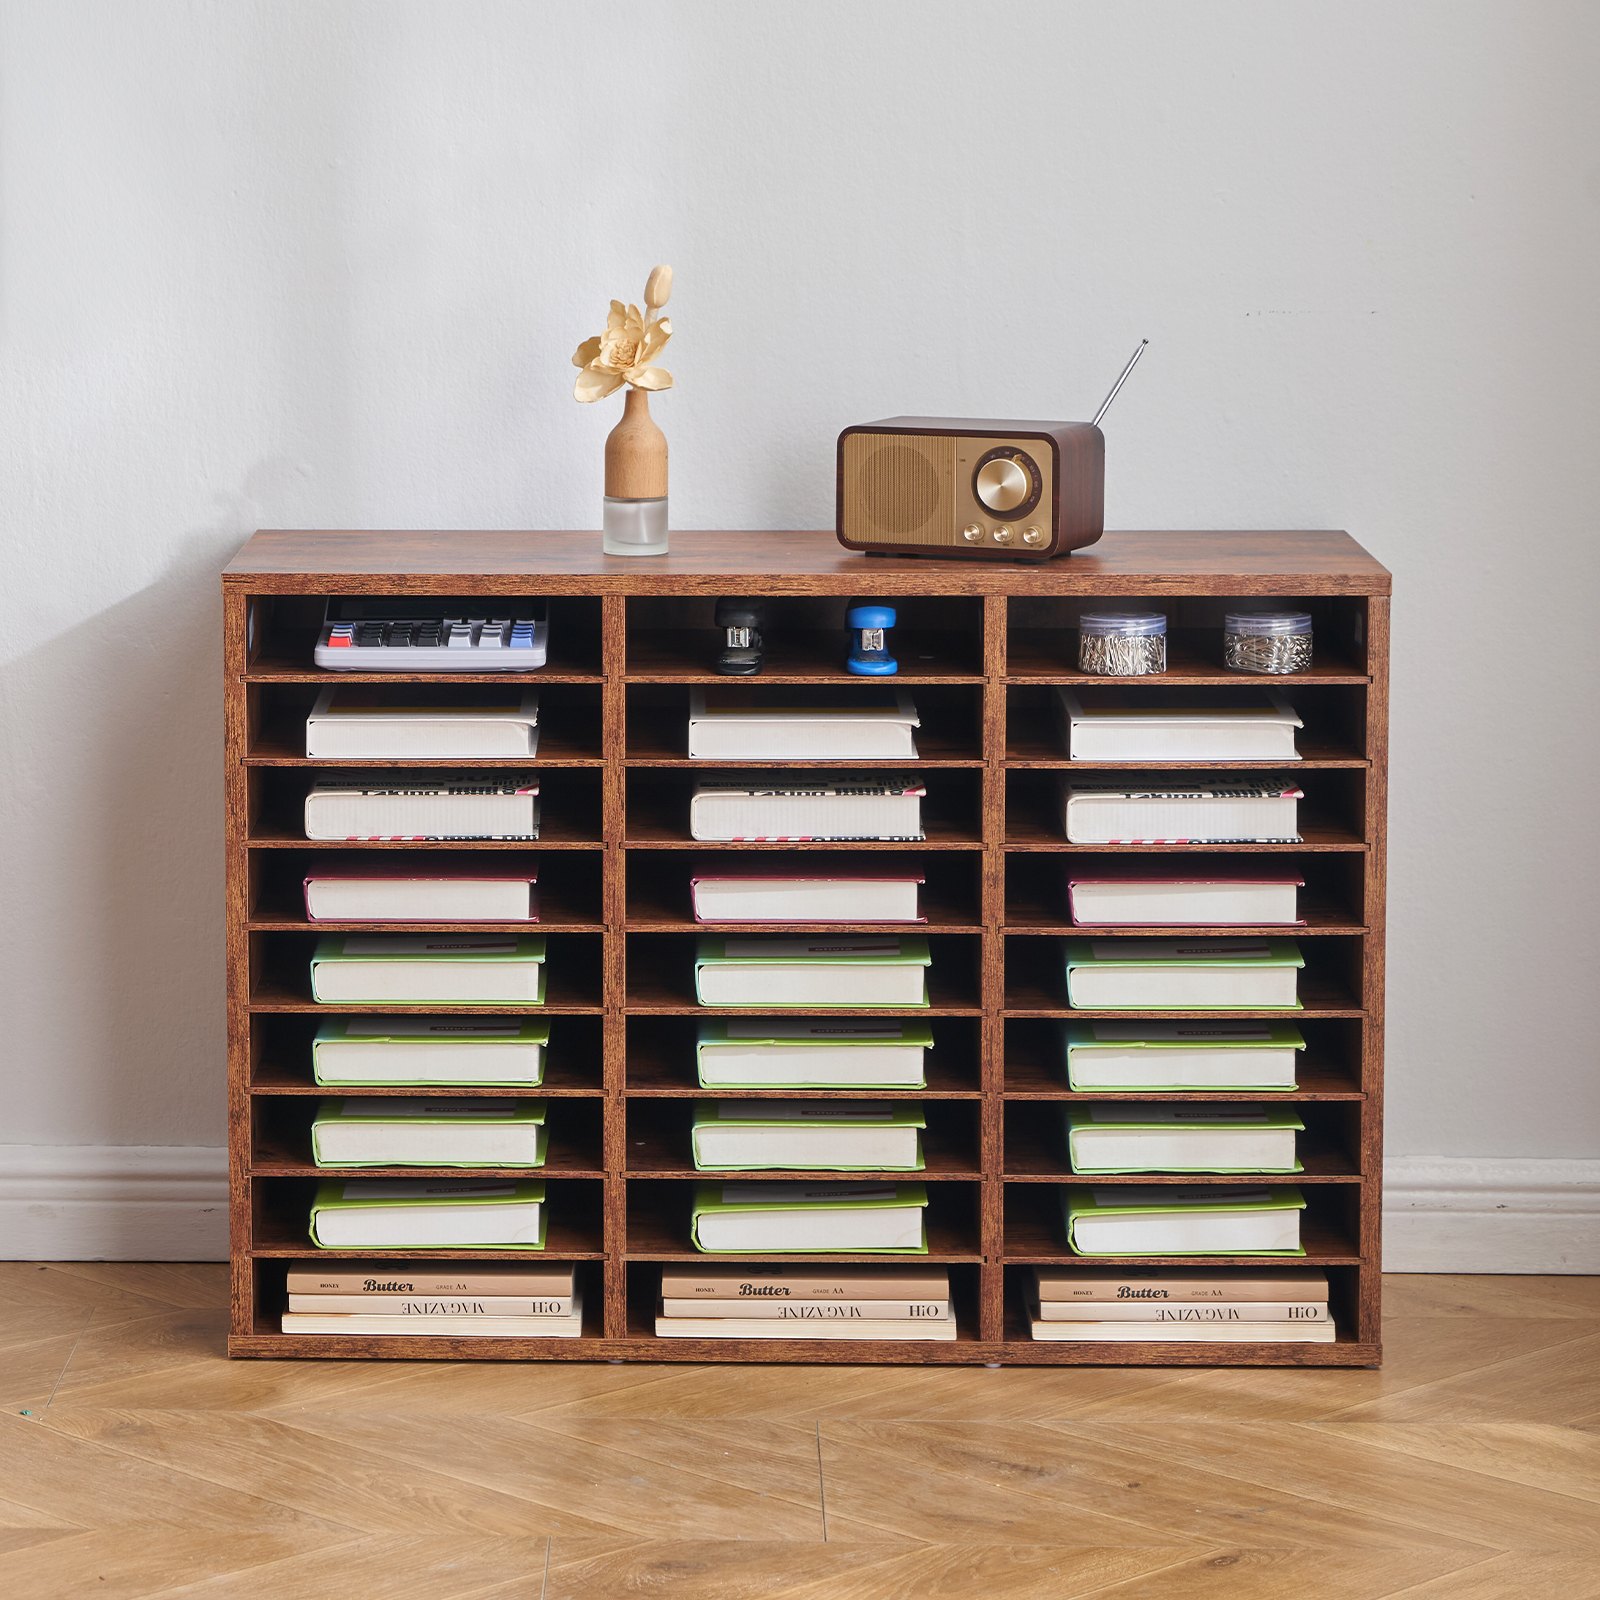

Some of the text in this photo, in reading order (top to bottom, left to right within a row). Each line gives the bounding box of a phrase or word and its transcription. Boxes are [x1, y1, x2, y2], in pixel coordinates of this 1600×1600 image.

[363, 1279, 414, 1292] Butter
[456, 1283, 467, 1291] AA
[739, 1284, 791, 1296] Butter
[833, 1287, 844, 1295] AA
[1117, 1286, 1169, 1298] Butter
[1211, 1289, 1223, 1297] AA
[402, 1303, 486, 1315] MAGAZINE
[777, 1306, 861, 1318] MAGAZINE
[1155, 1308, 1240, 1320] MAGAZINE
